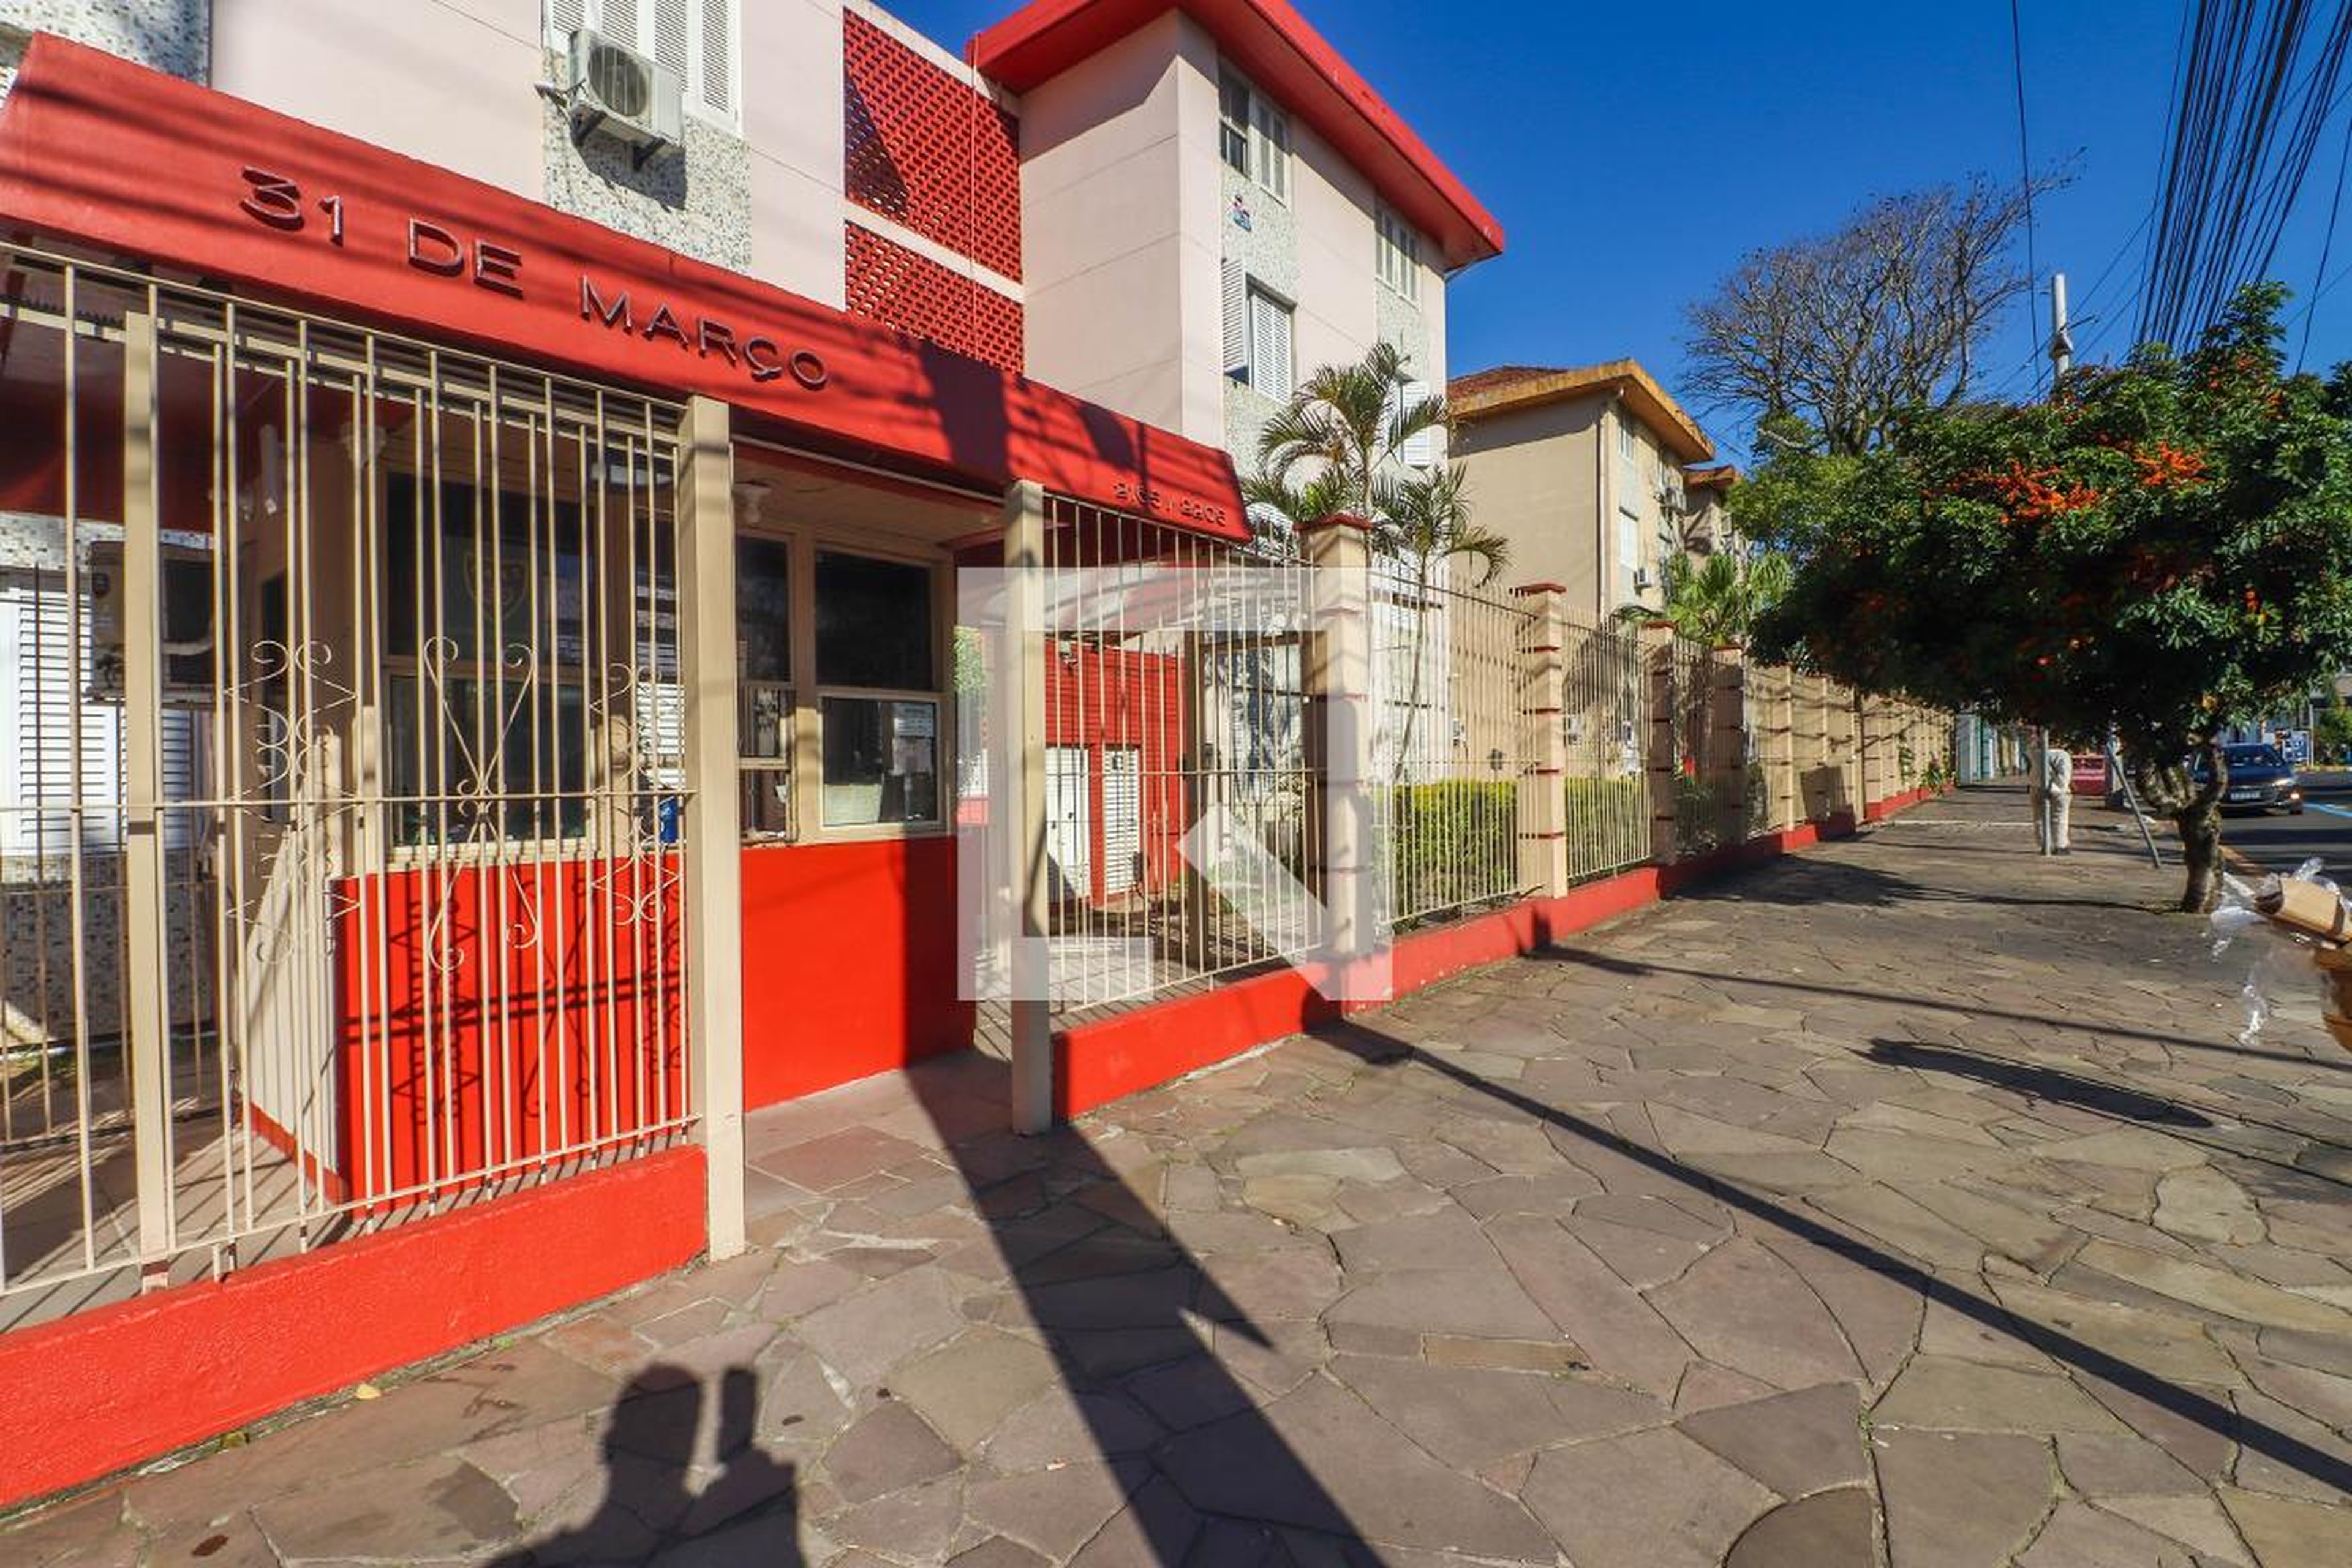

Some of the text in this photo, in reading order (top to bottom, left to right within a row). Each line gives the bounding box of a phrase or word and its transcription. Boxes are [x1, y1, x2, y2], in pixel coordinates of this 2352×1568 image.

[239, 164, 828, 391] 31 DE MARÇO
